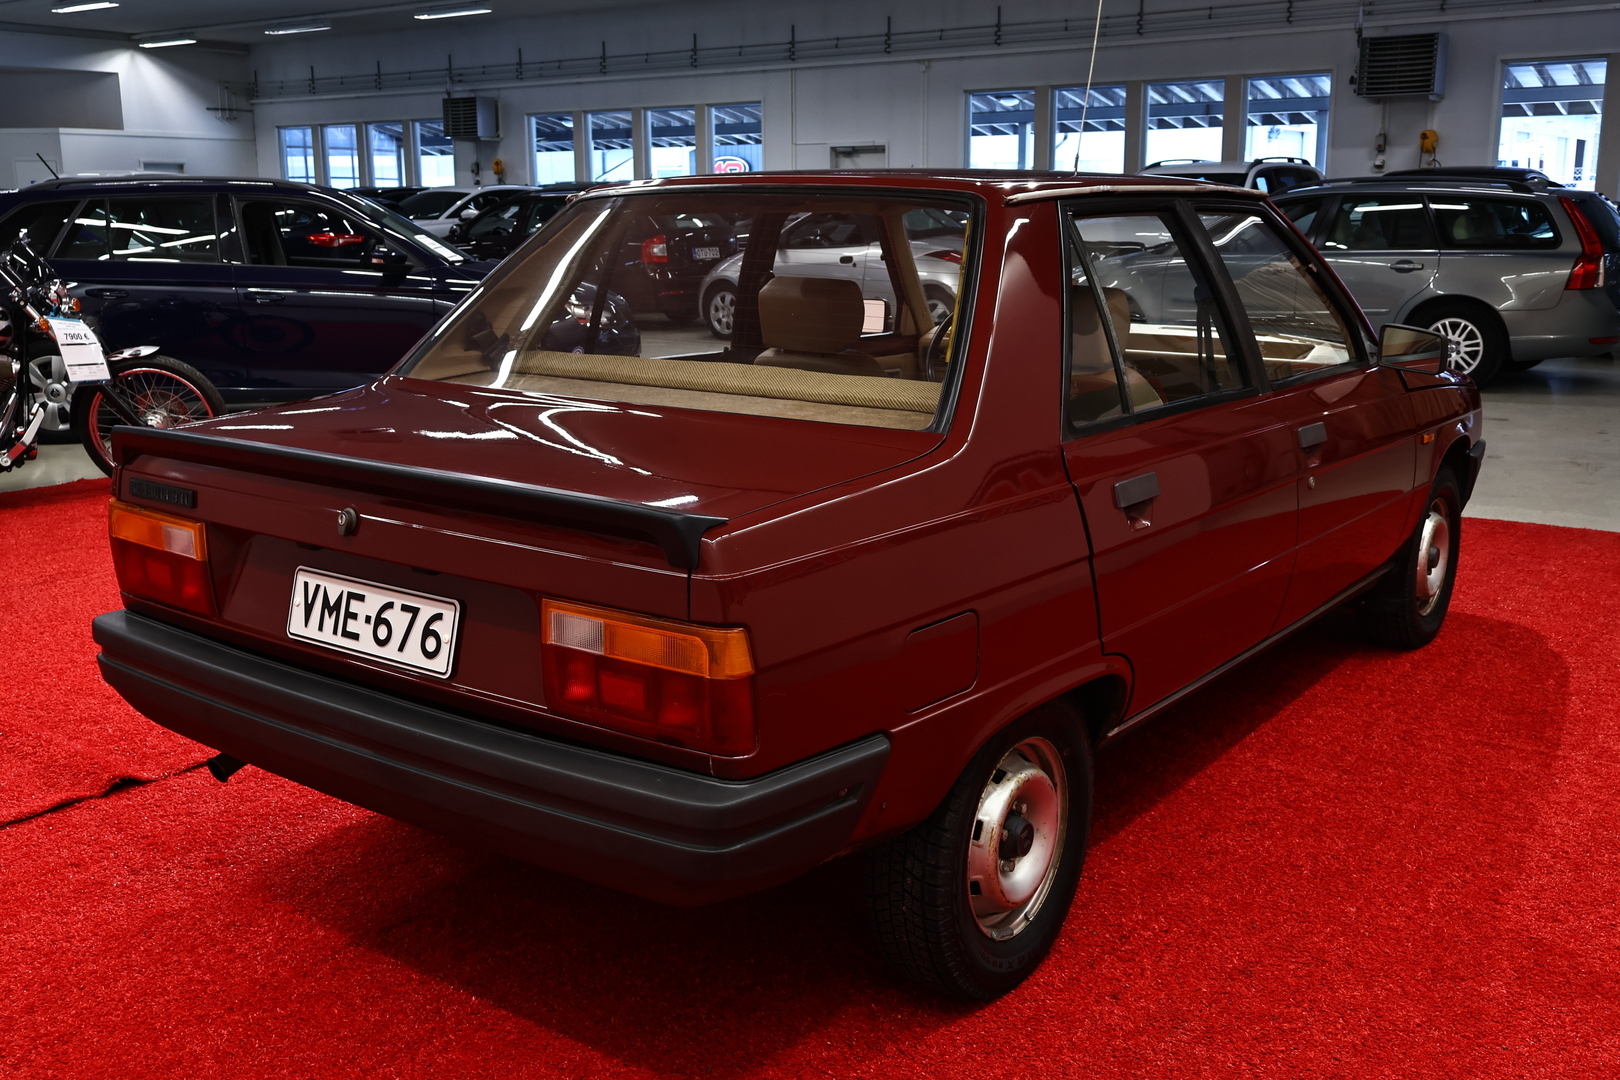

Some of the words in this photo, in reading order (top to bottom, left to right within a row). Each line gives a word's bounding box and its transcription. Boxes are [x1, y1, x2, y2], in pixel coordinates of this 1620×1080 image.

[63, 332, 83, 341] 7900
[83, 332, 90, 341] €
[303, 580, 444, 660] VME-676
